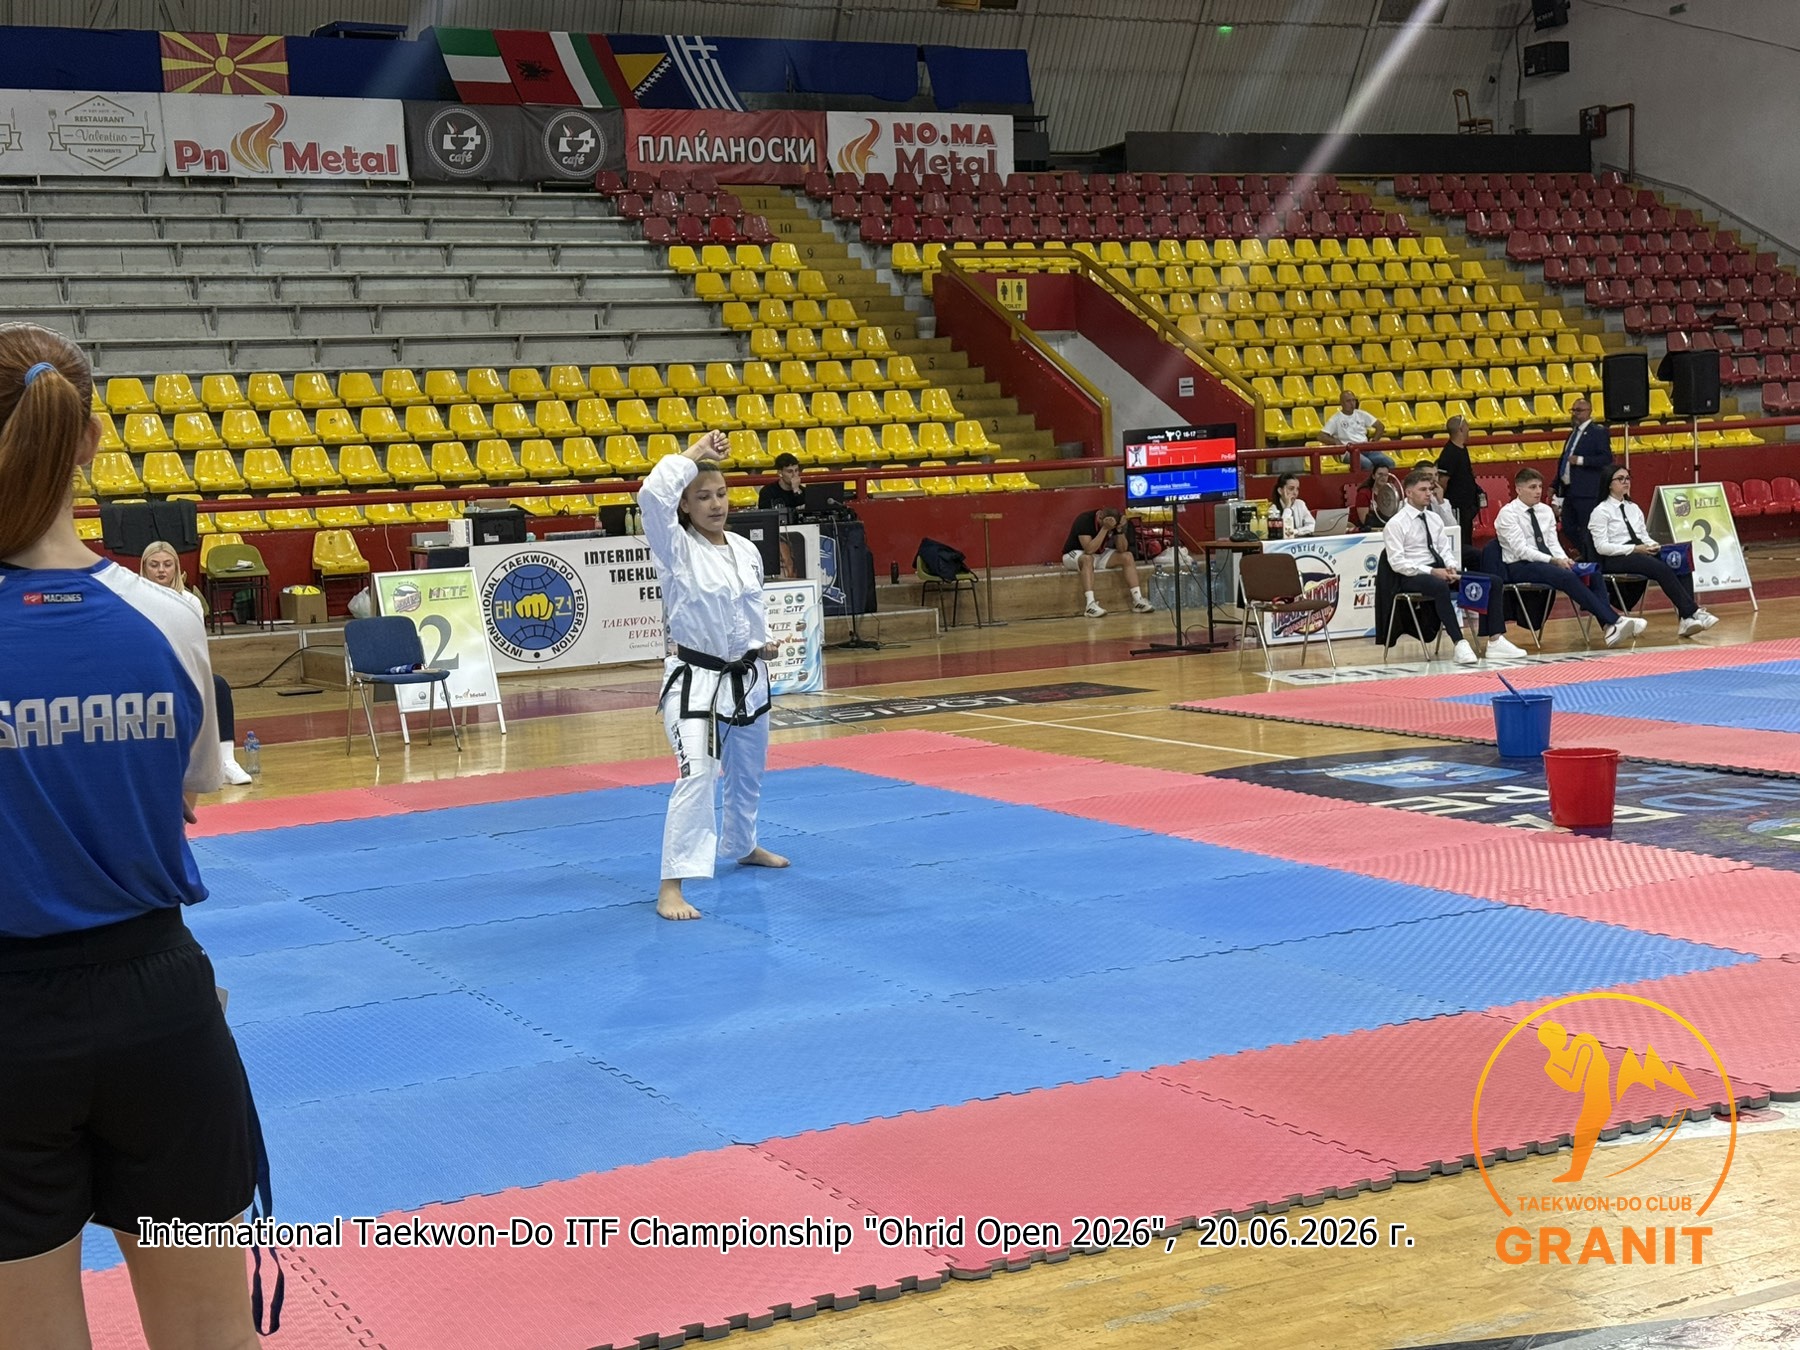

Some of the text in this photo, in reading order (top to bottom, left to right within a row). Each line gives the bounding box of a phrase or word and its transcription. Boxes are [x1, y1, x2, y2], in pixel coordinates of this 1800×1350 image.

[74, 114, 125, 123] RESTAURANT
[75, 128, 128, 143] Valentino
[892, 121, 996, 146] NO.MA
[636, 129, 817, 164] ПЛАЌАНОСКИ
[173, 139, 399, 174] Pn Metal
[448, 151, 473, 165] café
[561, 153, 585, 168] café
[894, 147, 998, 175] Metal
[757, 199, 768, 210] 11
[779, 222, 792, 234] 10
[806, 247, 814, 258] 9
[864, 300, 871, 312] 7
[894, 327, 901, 340] 6
[928, 356, 935, 370] 5
[956, 387, 964, 400] 4
[991, 419, 999, 433] 3
[1691, 518, 1720, 564] 3
[584, 547, 651, 566] INTERNAT
[1290, 543, 1338, 566] Ohrid Open
[500, 554, 575, 582] TAEKWON-DO
[609, 566, 658, 583] TAEKW
[43, 592, 83, 603] MACHINES
[639, 585, 663, 600] FED
[481, 576, 524, 659] INTERNATIONAL
[551, 588, 585, 656] FEDERATION
[602, 615, 664, 629] TAEKWON-
[628, 627, 664, 640] EVERY
[418, 614, 460, 670] 2
[769, 694, 1019, 728] LOGISTI
